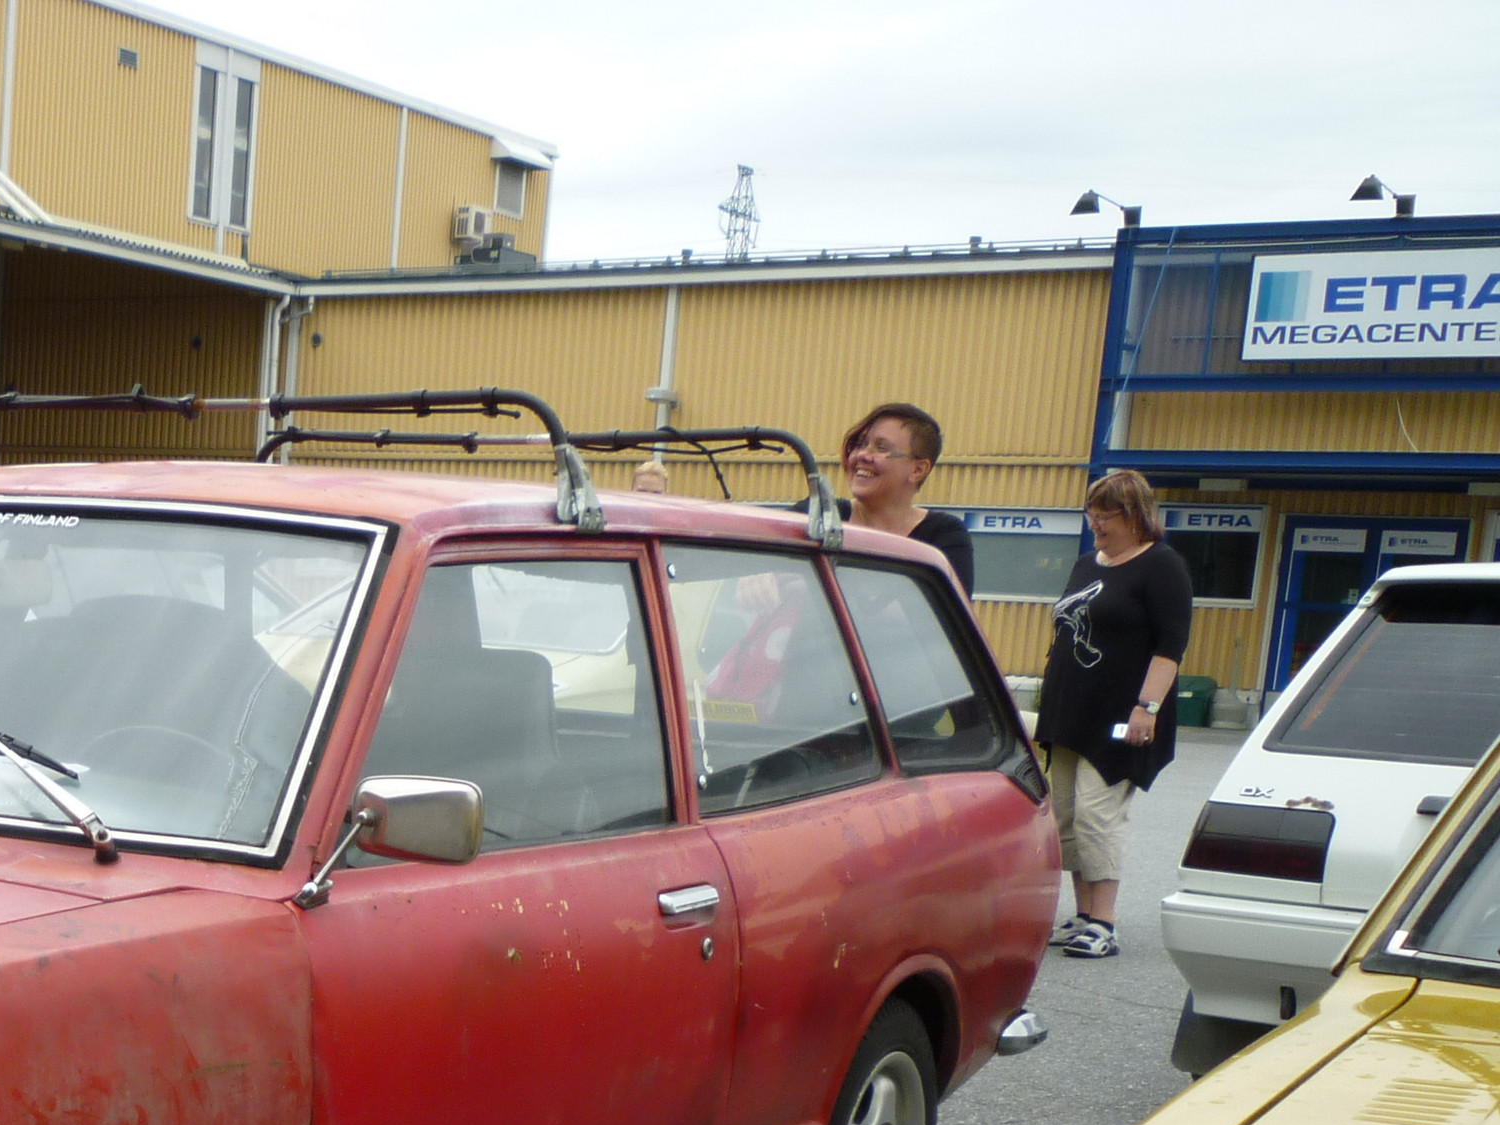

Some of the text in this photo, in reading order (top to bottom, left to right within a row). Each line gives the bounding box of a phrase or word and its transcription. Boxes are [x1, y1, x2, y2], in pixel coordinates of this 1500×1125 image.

[1323, 273, 1500, 313] ETRA
[1251, 321, 1500, 345] MEGACENTE
[13, 513, 80, 527] FINLAND
[984, 515, 1042, 529] ETRA
[1187, 513, 1252, 528] ETRA
[1239, 786, 1275, 799] DX
